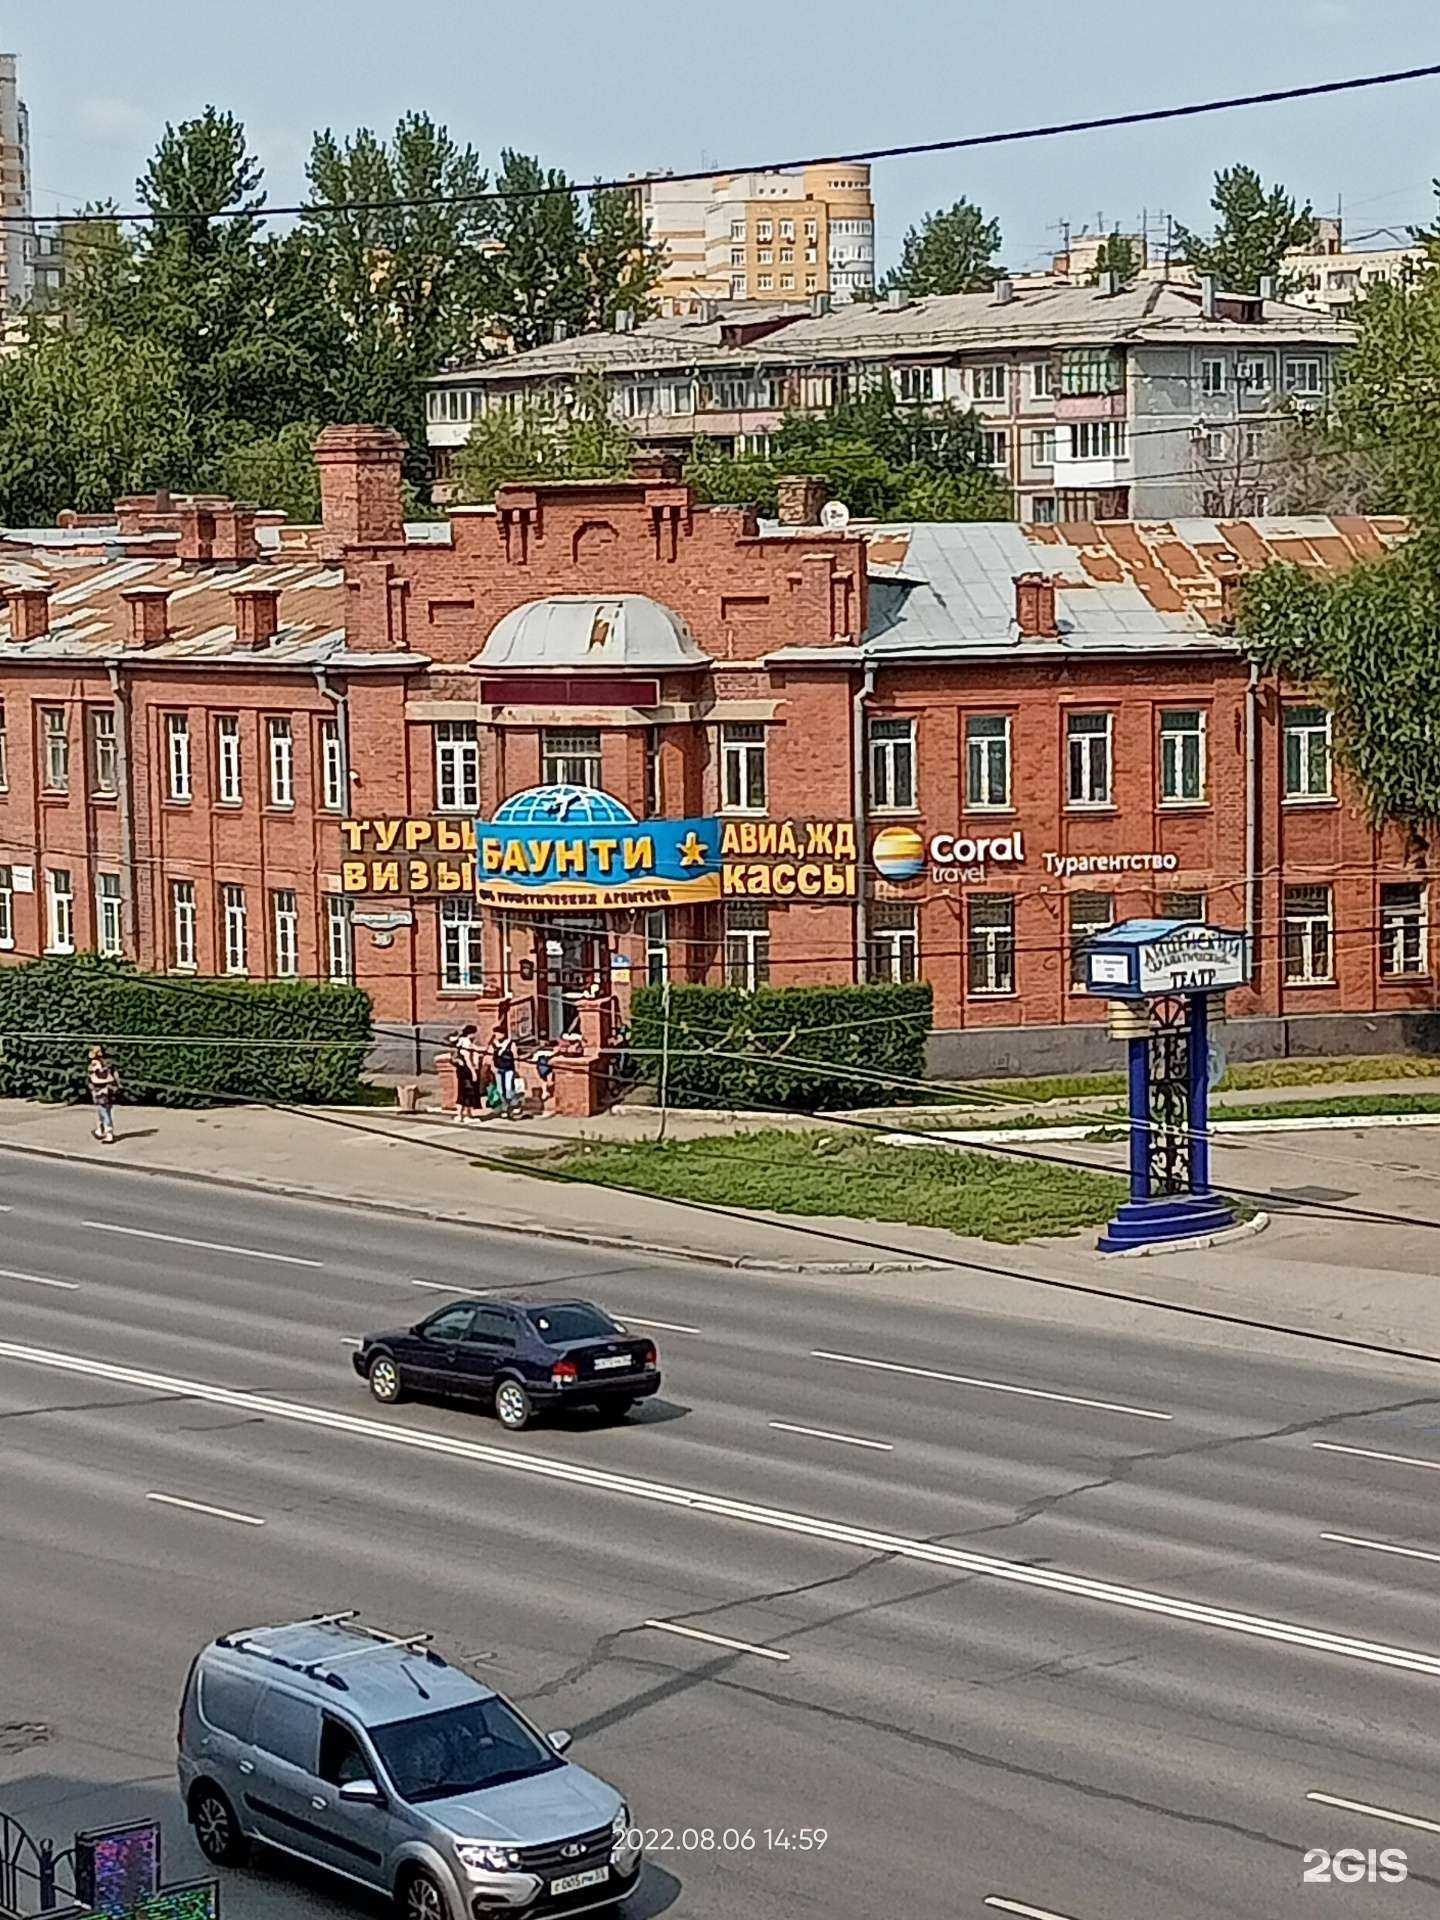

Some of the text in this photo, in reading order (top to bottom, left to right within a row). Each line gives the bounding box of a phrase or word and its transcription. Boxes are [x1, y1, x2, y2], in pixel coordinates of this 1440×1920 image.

[341, 820, 477, 851] ТУРЫ
[930, 831, 1024, 863] Coral
[482, 836, 653, 874] БАУНТИ
[1042, 852, 1177, 877] Турагентство
[343, 861, 472, 891] ВИЗЫ
[932, 864, 987, 883] travel
[1170, 968, 1216, 990] ТЕАТР
